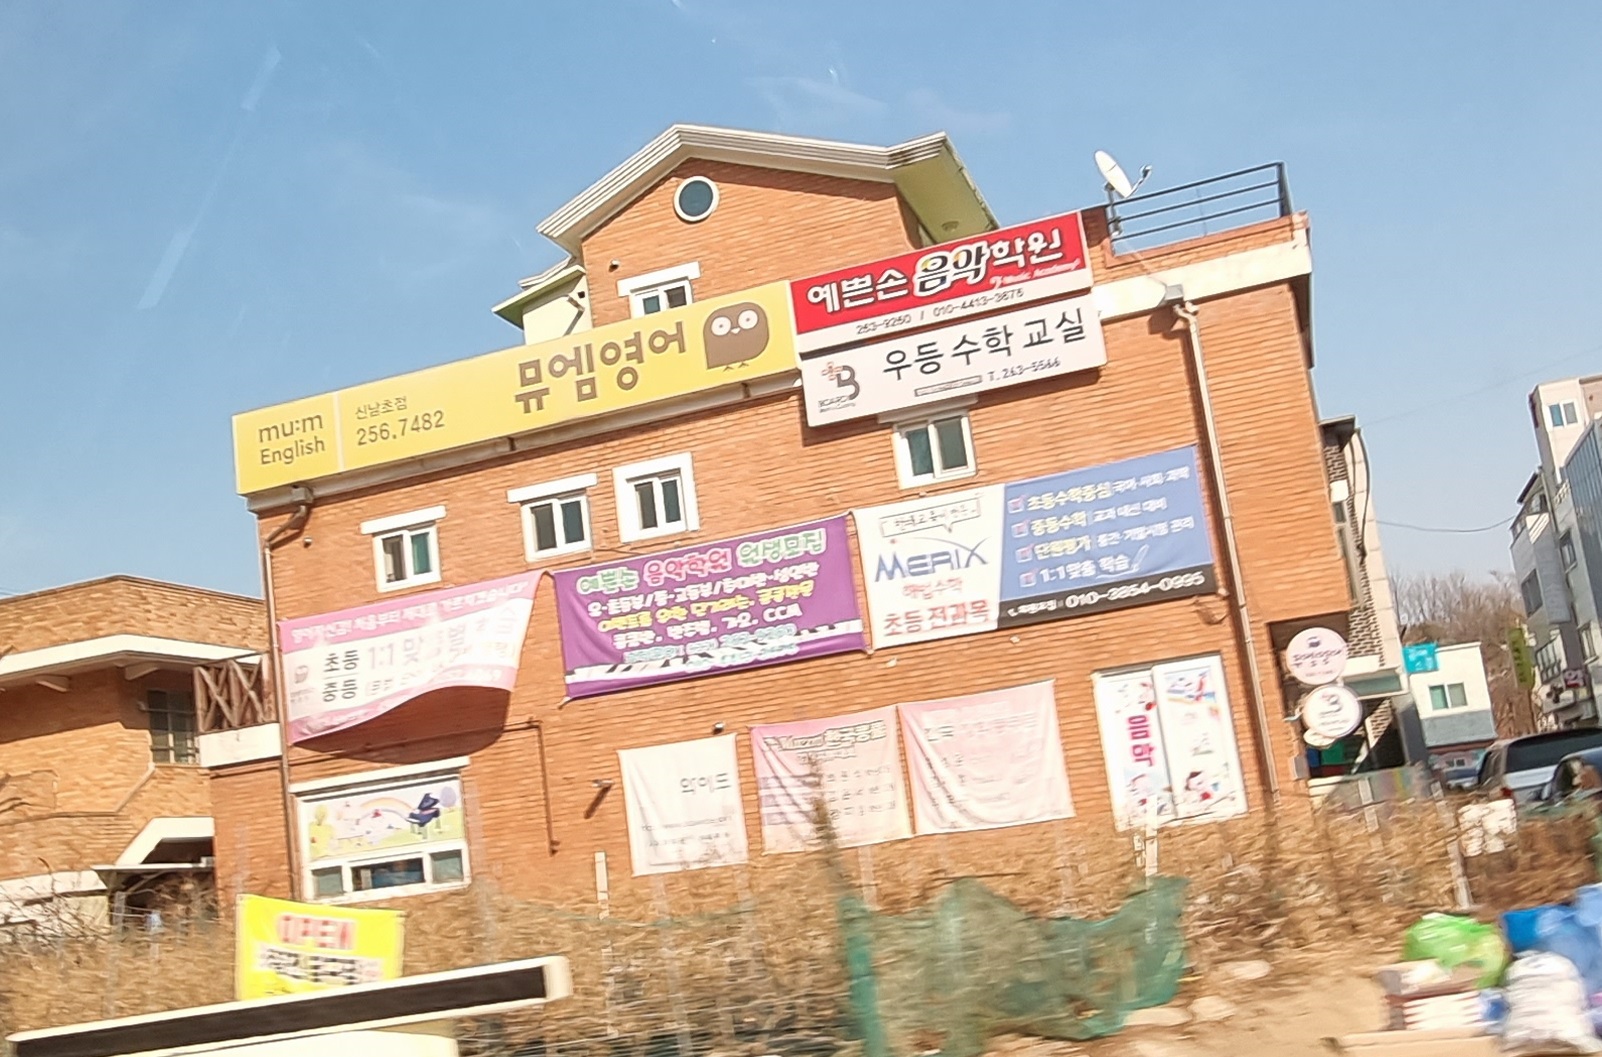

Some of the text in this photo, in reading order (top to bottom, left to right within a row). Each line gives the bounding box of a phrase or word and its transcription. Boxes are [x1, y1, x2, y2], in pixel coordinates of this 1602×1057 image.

[807, 268, 908, 313] 예쁜손
[883, 307, 1086, 381] 우등 수학 교실
[515, 321, 686, 414] 뮤엠영어
[258, 412, 324, 443] mu:m
[356, 411, 445, 446] 256.7482
[260, 437, 325, 466] English
[323, 650, 359, 672] 초등
[323, 679, 358, 703] 중등
